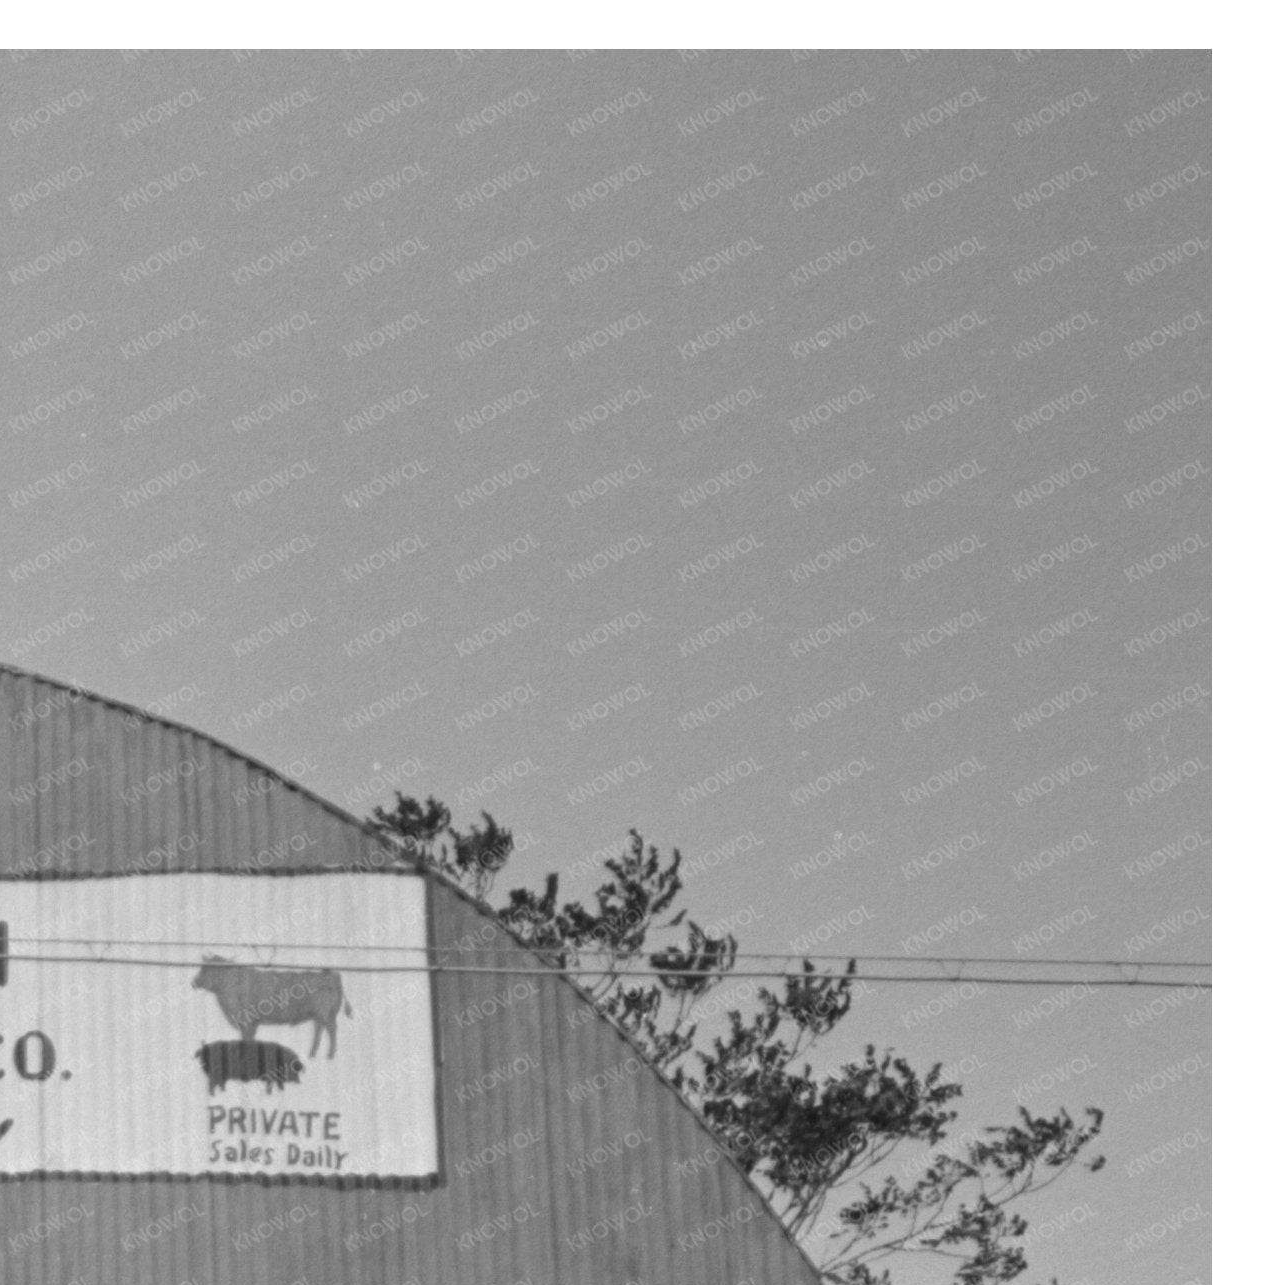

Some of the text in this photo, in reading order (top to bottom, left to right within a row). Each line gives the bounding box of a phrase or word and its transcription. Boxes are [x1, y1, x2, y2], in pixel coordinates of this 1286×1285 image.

[207, 1104, 342, 1141] PRIVATE
[208, 1139, 350, 1171] Sales Daily
